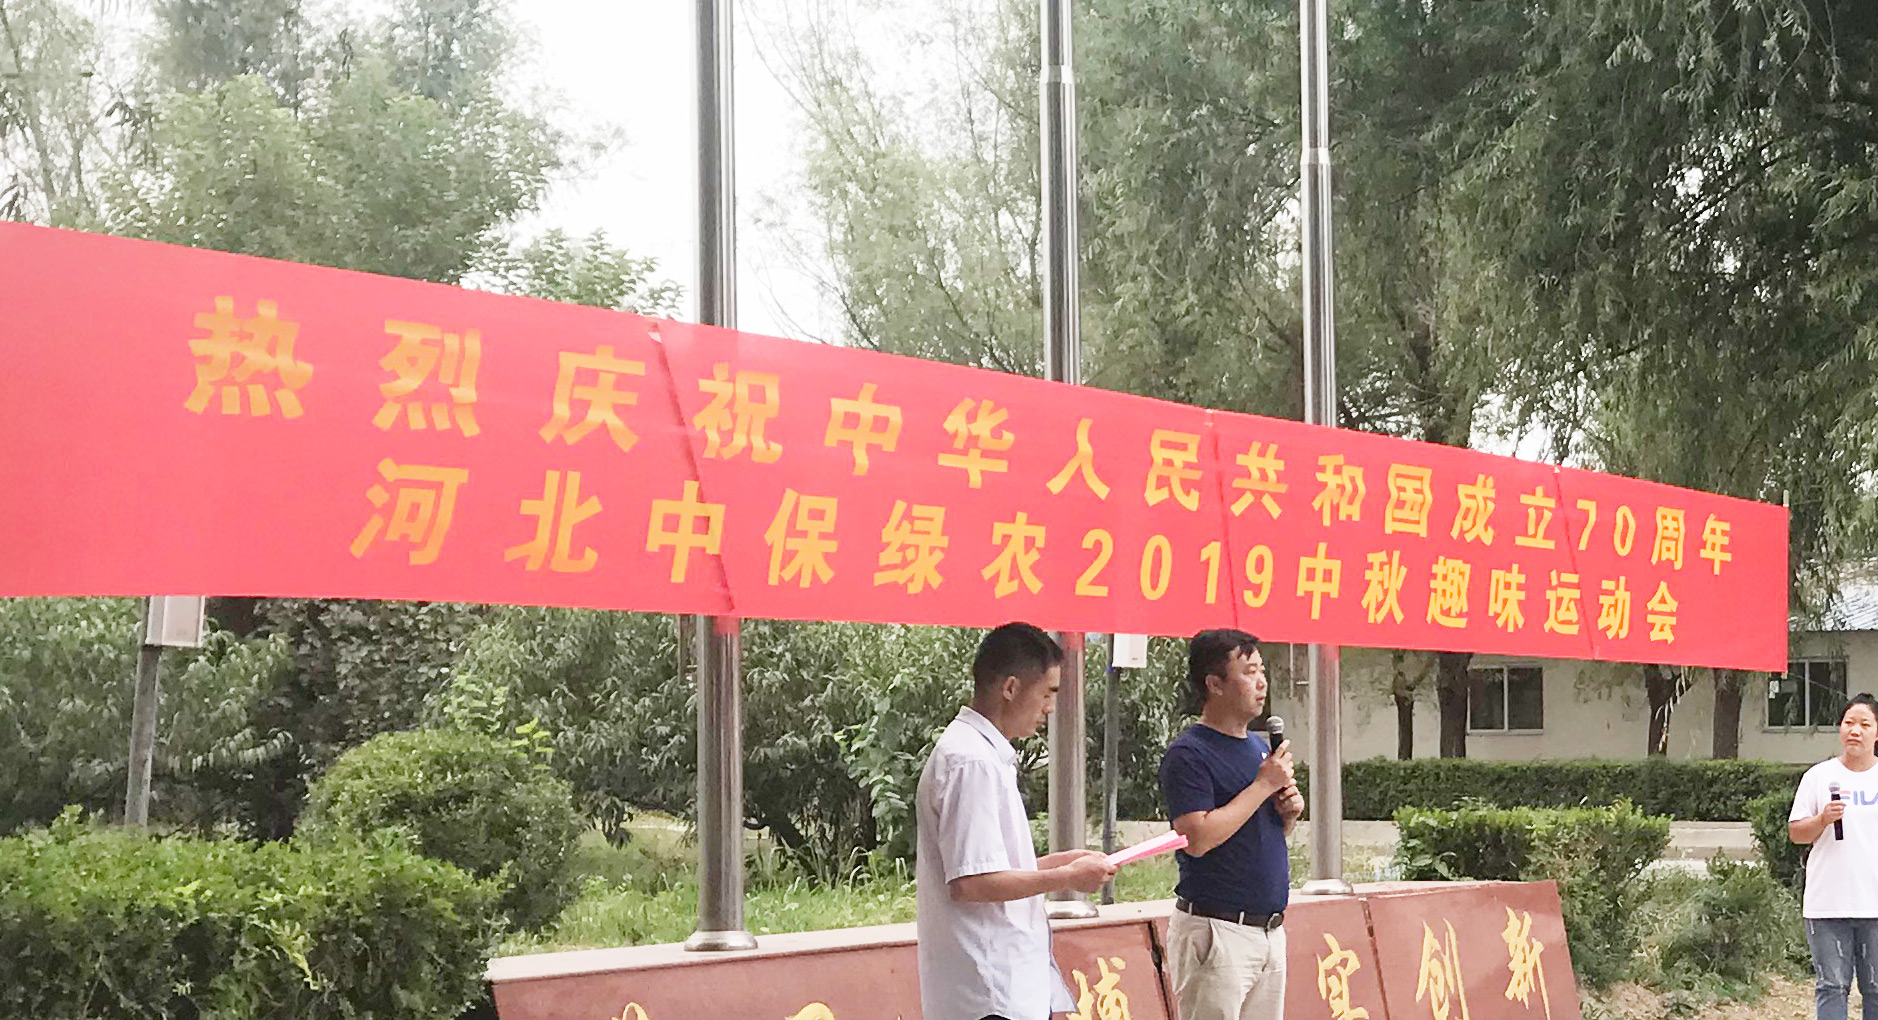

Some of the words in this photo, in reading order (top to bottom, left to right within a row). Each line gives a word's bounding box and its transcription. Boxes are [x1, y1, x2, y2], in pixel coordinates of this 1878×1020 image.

[184, 296, 1733, 575] 热烈庆祝中华人民共和国成立70周年
[350, 458, 1678, 643] 河北中保绿农2019中秋趣味运动会
